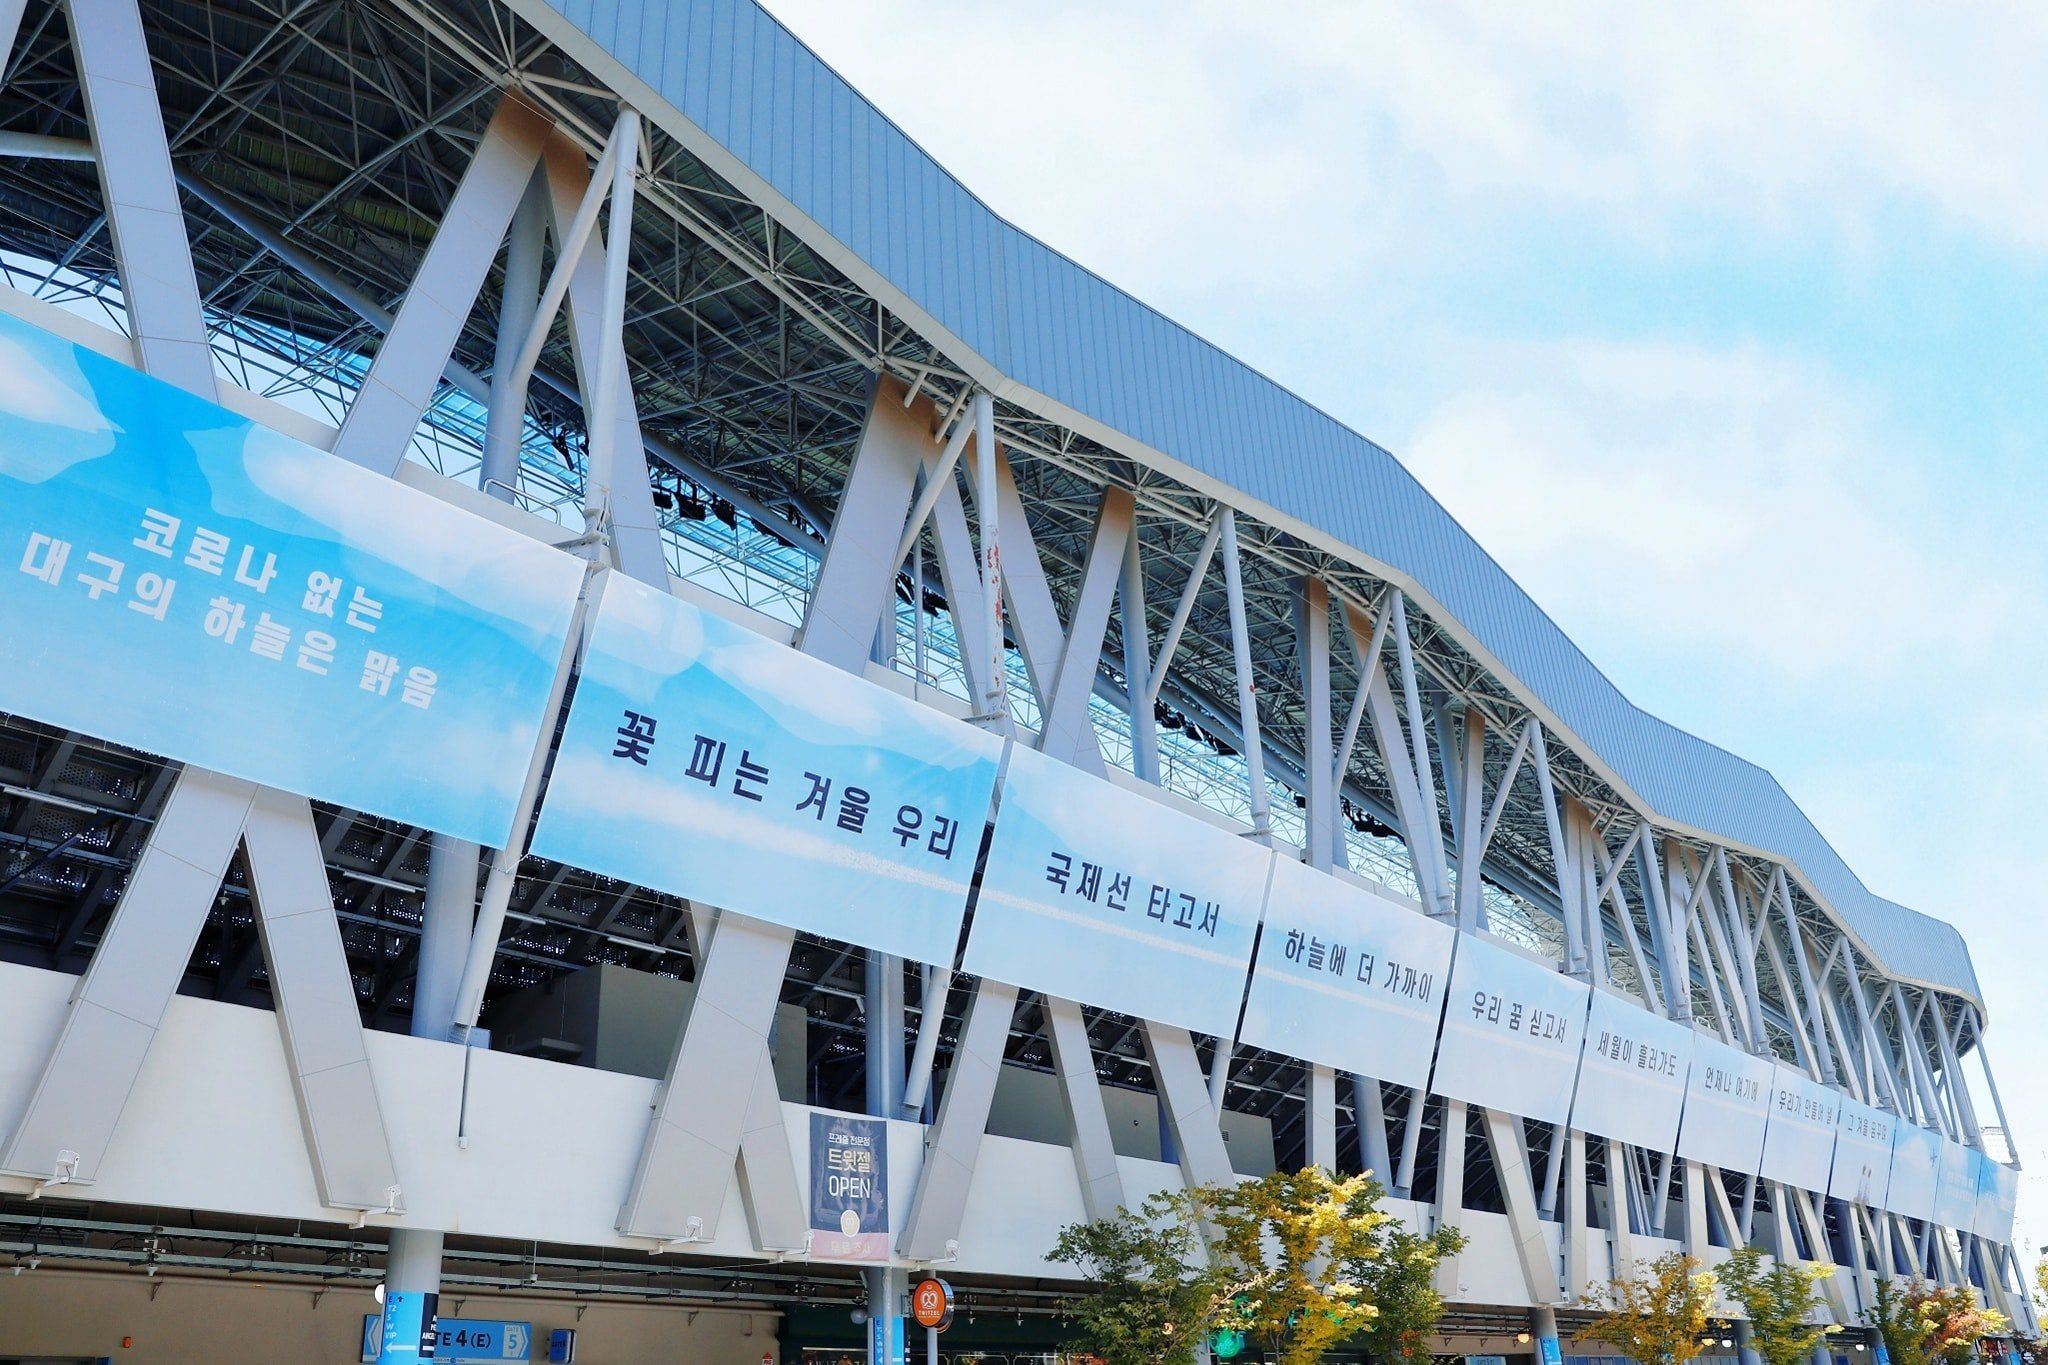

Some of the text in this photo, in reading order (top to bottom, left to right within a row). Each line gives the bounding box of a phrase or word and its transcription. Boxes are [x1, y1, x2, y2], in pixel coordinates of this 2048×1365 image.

[133, 506, 384, 634] 코로나 없는
[19, 532, 440, 711] 대구의 하늘은 맑음
[612, 709, 960, 861] 꽃 피는 겨울 우리
[1046, 851, 1220, 938] 국제선 타고서
[1284, 928, 1434, 1004] 하늘에 더 가까이
[1471, 991, 1568, 1044] 우리 꿈 싣고서
[1596, 1031, 1678, 1077] 세월이 흘러가도
[1704, 1067, 1732, 1094] 언제나
[1778, 1090, 1802, 1115] 우리가
[850, 1135, 871, 1147] 전문점
[828, 1148, 871, 1173] 트윗젤
[829, 1175, 871, 1198] OPEN
[388, 1304, 397, 1312] T2
[385, 1332, 397, 1340] VIP
[434, 1330, 492, 1348] TE 4 (E)
[508, 1334, 518, 1350] 5
